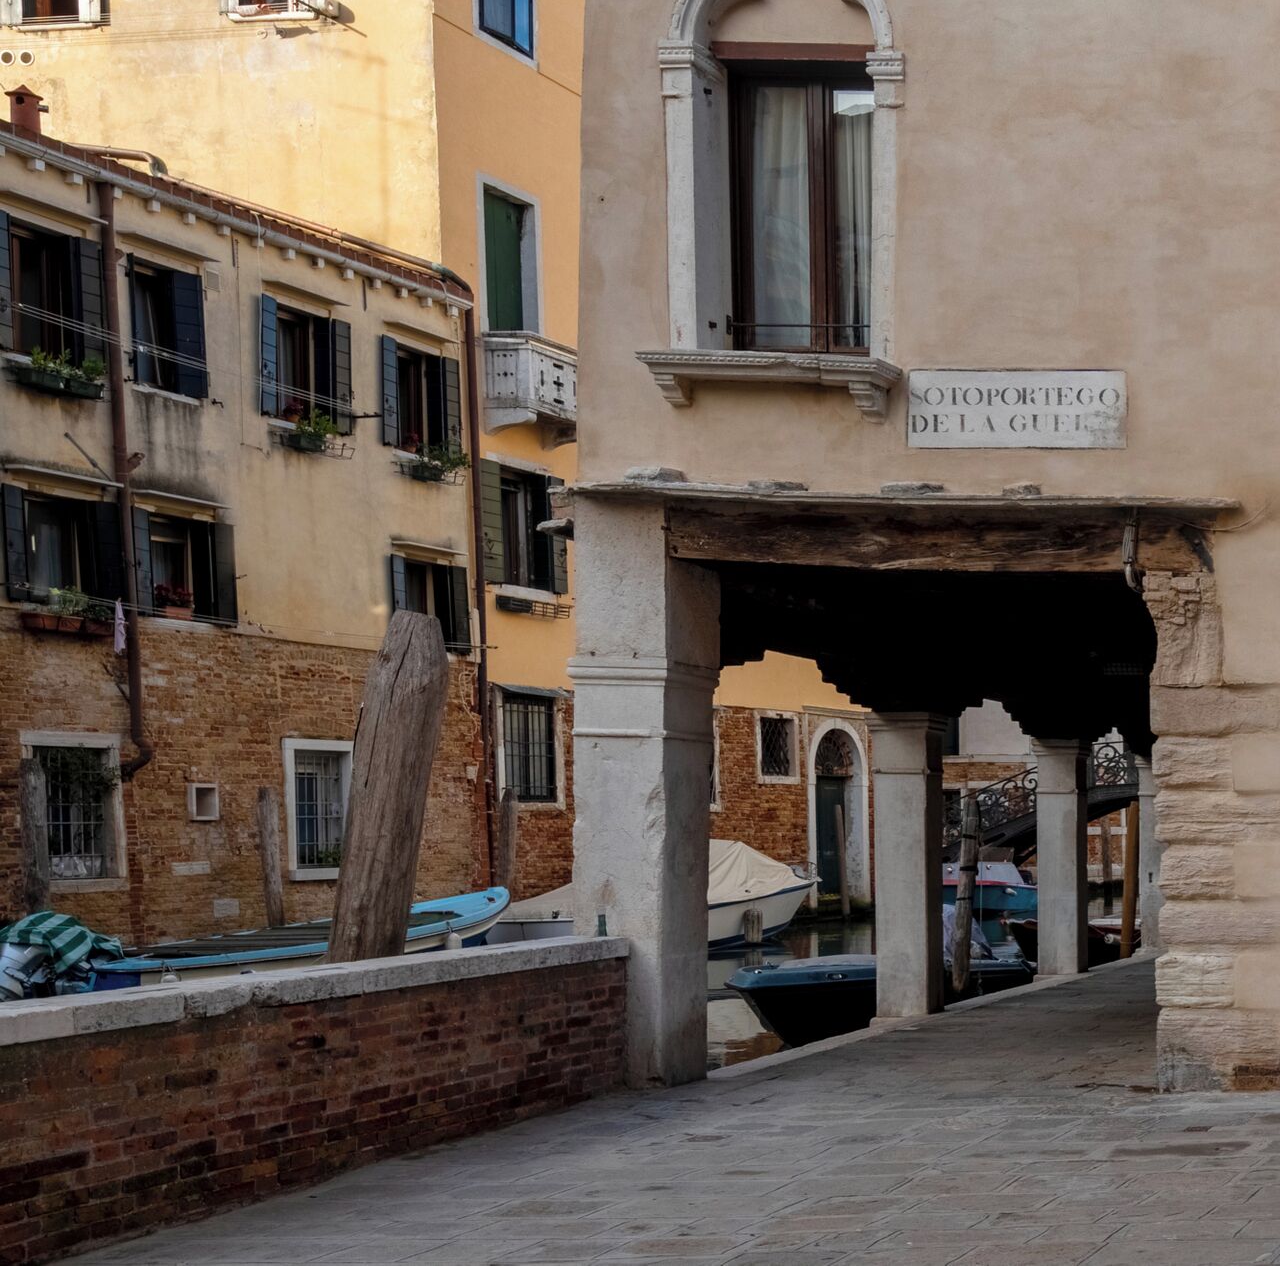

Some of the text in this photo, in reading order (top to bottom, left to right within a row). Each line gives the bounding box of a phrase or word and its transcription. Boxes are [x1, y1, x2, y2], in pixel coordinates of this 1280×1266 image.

[910, 387, 1120, 406] SOTOPORTEGO
[911, 414, 949, 433] DE
[960, 414, 997, 433] LA
